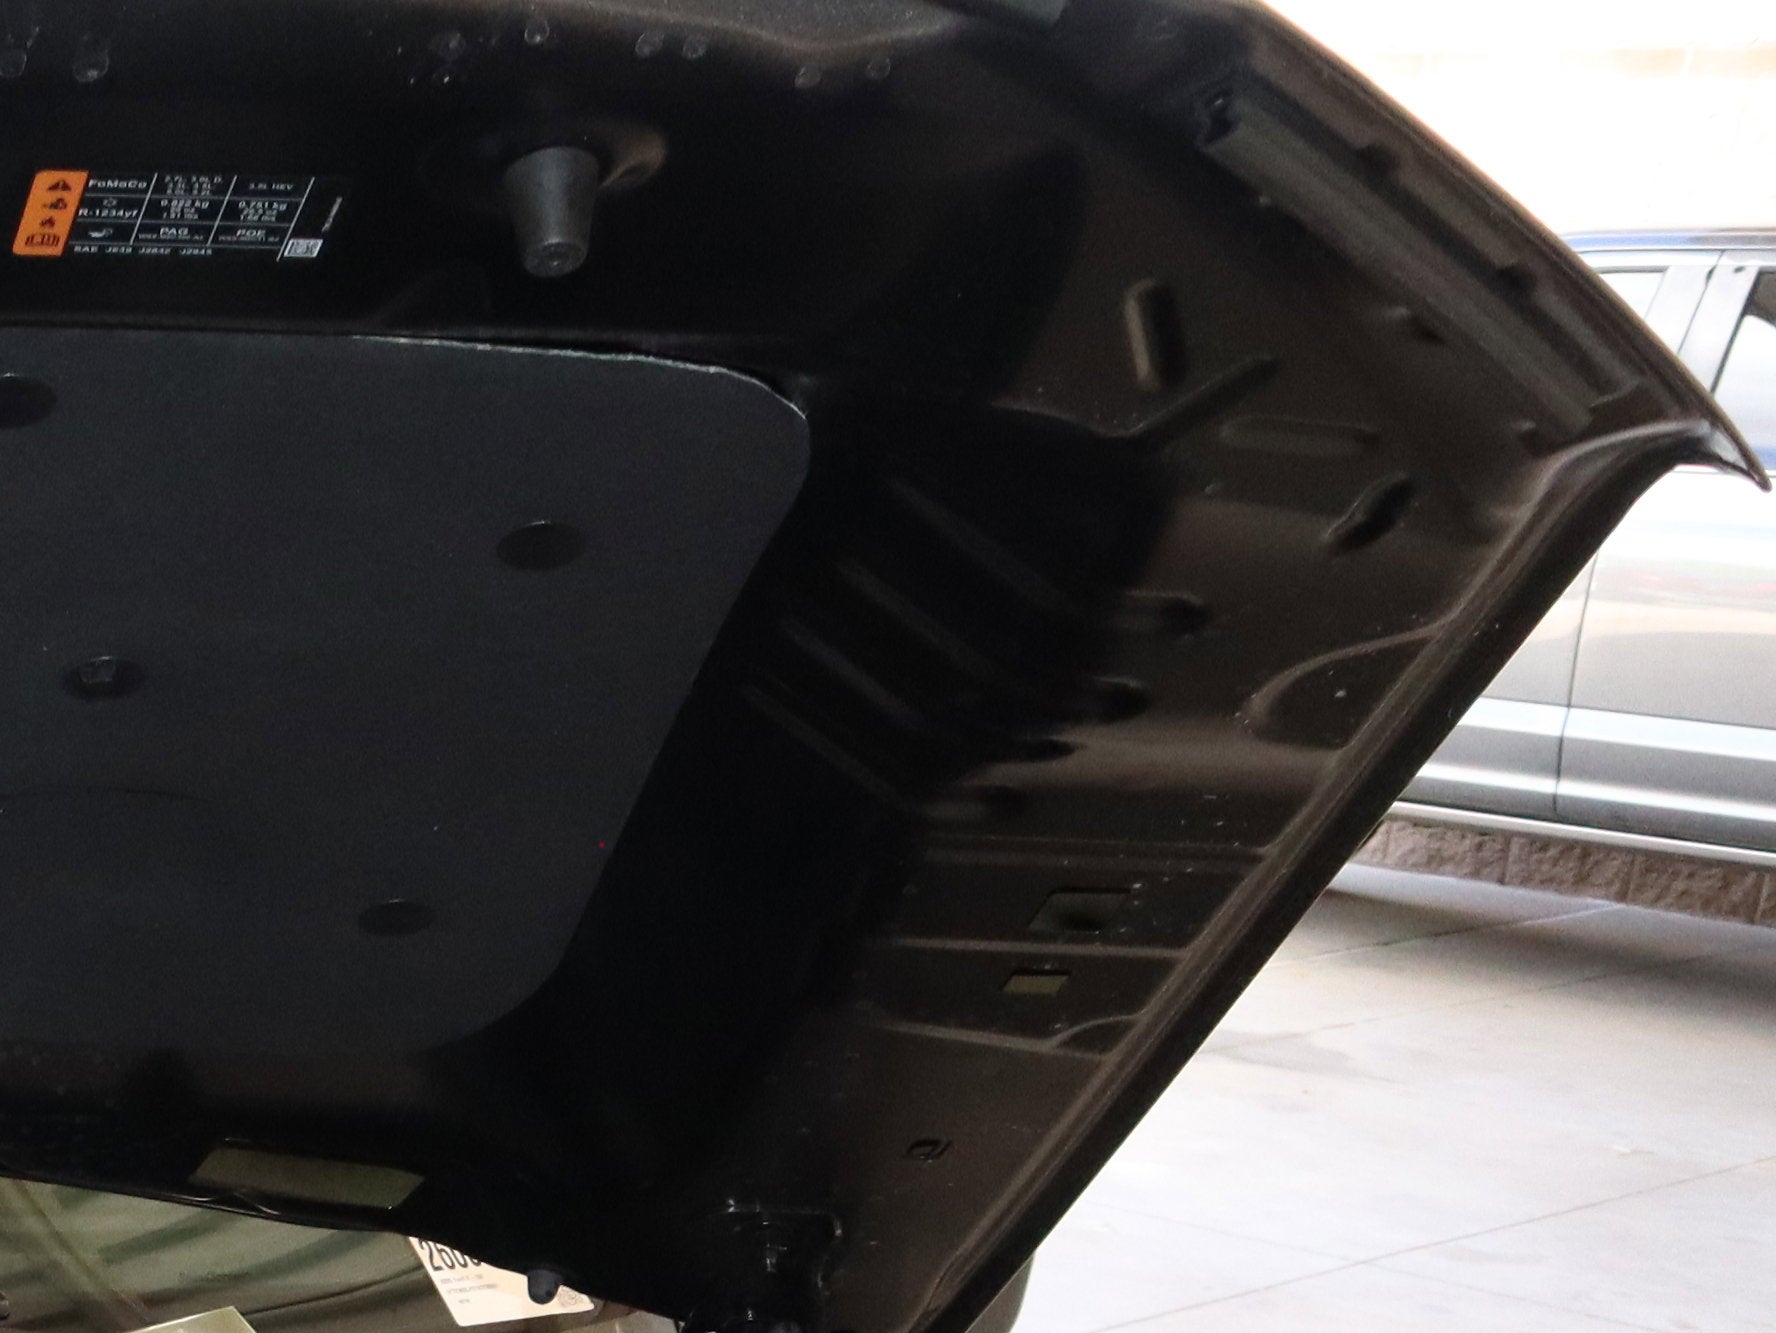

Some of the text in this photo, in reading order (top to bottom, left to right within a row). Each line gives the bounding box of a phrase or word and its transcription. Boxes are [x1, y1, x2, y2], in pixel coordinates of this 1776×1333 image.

[88, 179, 147, 189] FoMoCo
[272, 183, 294, 191] HEV
[272, 201, 287, 211] kg
[78, 208, 138, 218] R-1234yf
